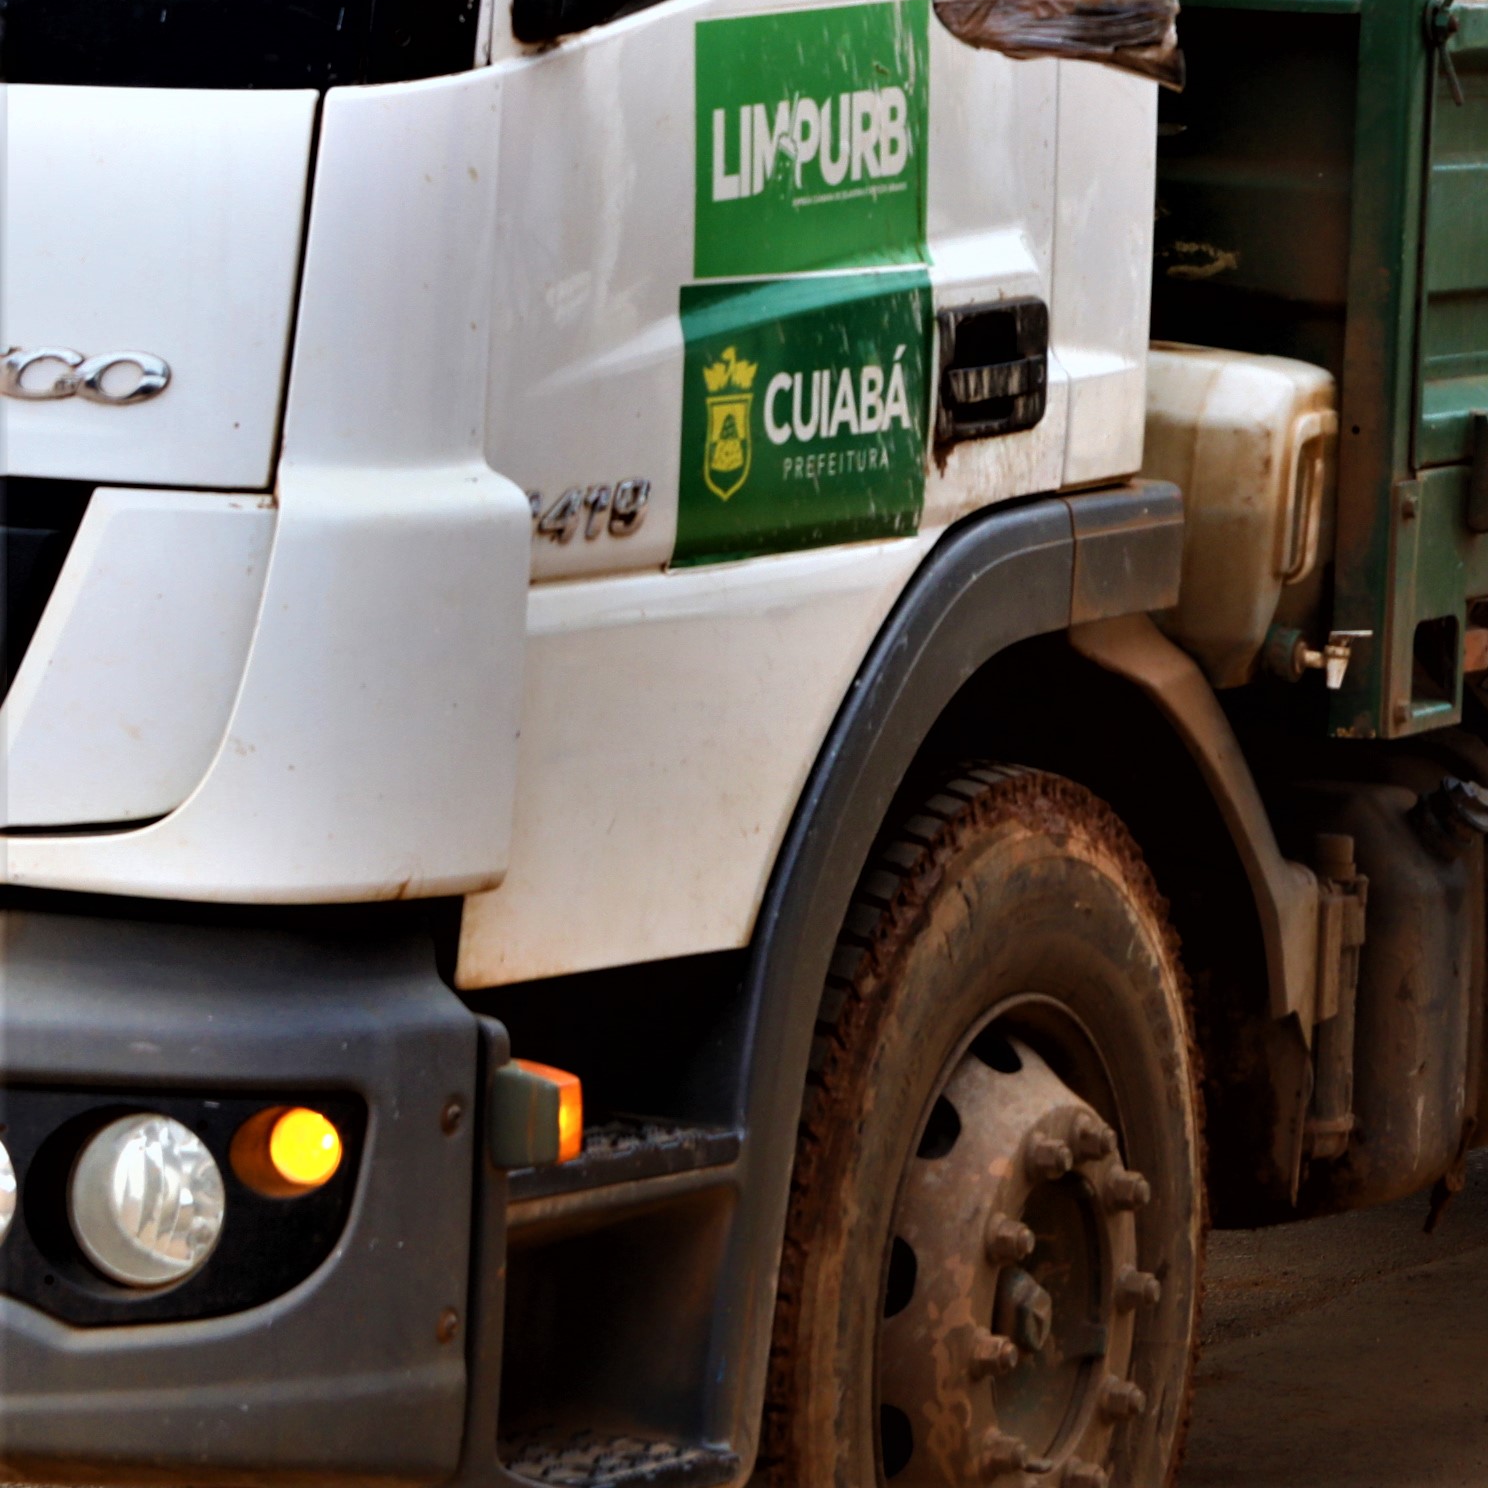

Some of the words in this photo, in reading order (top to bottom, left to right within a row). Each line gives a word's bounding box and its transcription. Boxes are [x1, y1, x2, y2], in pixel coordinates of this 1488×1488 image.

[712, 85, 908, 202] LIMPURB
[763, 343, 912, 445] CUIABÁ
[783, 447, 890, 480] PREFEITURA
